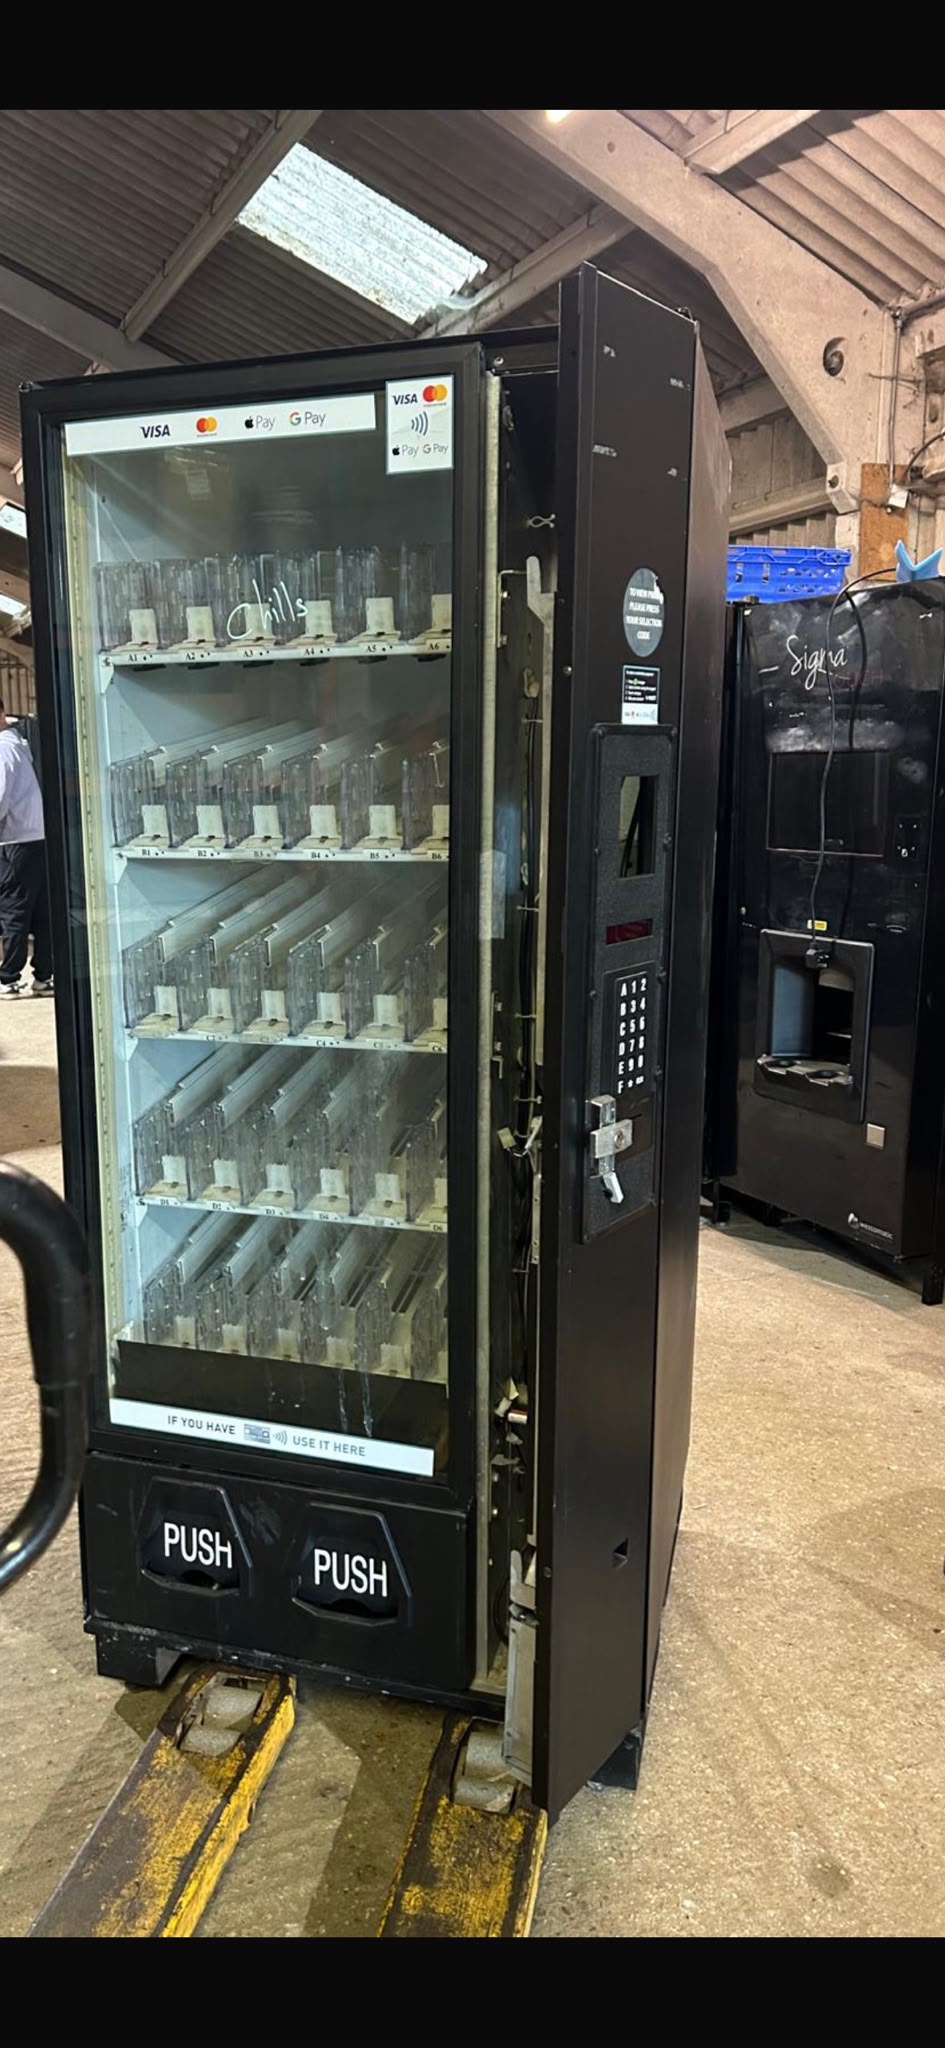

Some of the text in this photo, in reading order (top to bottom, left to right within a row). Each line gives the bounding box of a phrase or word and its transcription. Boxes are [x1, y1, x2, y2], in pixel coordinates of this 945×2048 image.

[392, 394, 418, 406] VISA
[256, 415, 276, 430] Pay
[304, 411, 327, 427] Pay
[140, 424, 171, 438] VISA
[402, 444, 419, 457] Pay
[433, 443, 449, 455] Pay
[639, 616, 662, 627] SELECTION
[637, 630, 651, 640] CODE
[304, 647, 315, 656] A4
[366, 645, 377, 653] A5
[428, 642, 440, 651] A6
[127, 654, 138, 662] A1
[185, 652, 196, 660] A2
[243, 650, 254, 658] A3
[786, 634, 848, 690] Sigma
[620, 977, 647, 997] A 1 2
[620, 997, 646, 1017] B 3 4
[619, 1016, 645, 1036] C 5 6
[618, 1035, 645, 1056] D 7 8
[618, 1054, 644, 1075] E 9 0
[617, 1080, 624, 1094] F
[167, 1414, 366, 1457] IF YOU HAVE USE IT HERE
[163, 1521, 233, 1569] PUSH
[313, 1548, 388, 1597] PUSH
